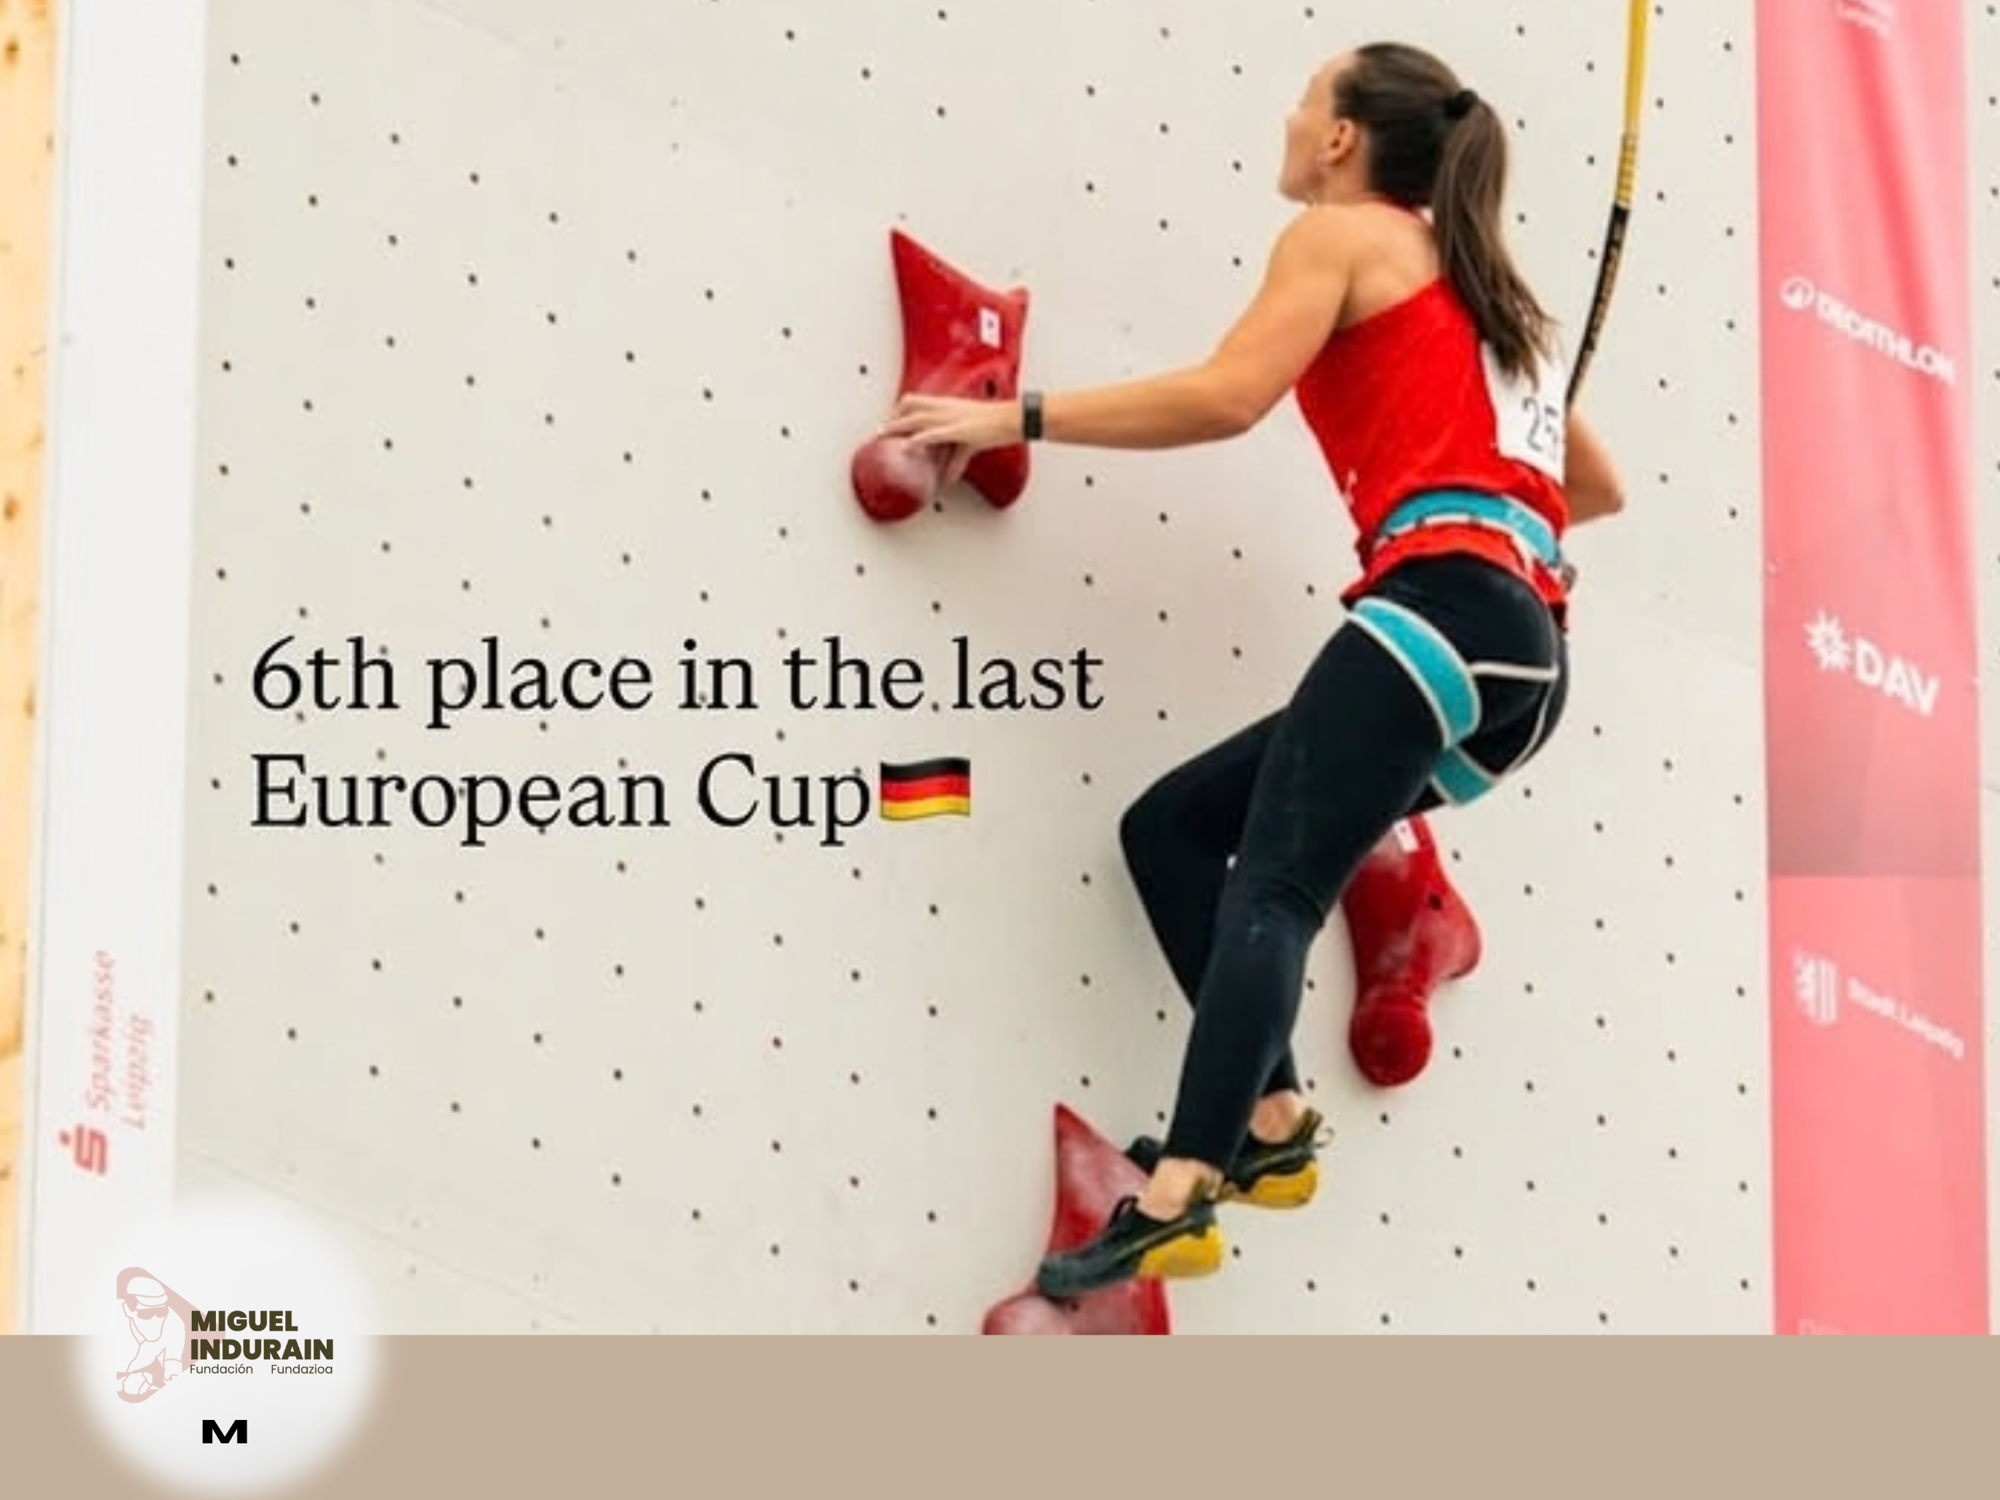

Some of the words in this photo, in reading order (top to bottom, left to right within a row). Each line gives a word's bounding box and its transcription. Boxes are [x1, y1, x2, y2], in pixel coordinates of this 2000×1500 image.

[1816, 291, 1954, 384] DECATHLON
[1855, 638, 1940, 716] DAV
[87, 950, 115, 1112] Sparkasse
[121, 1014, 153, 1131] Leipzig
